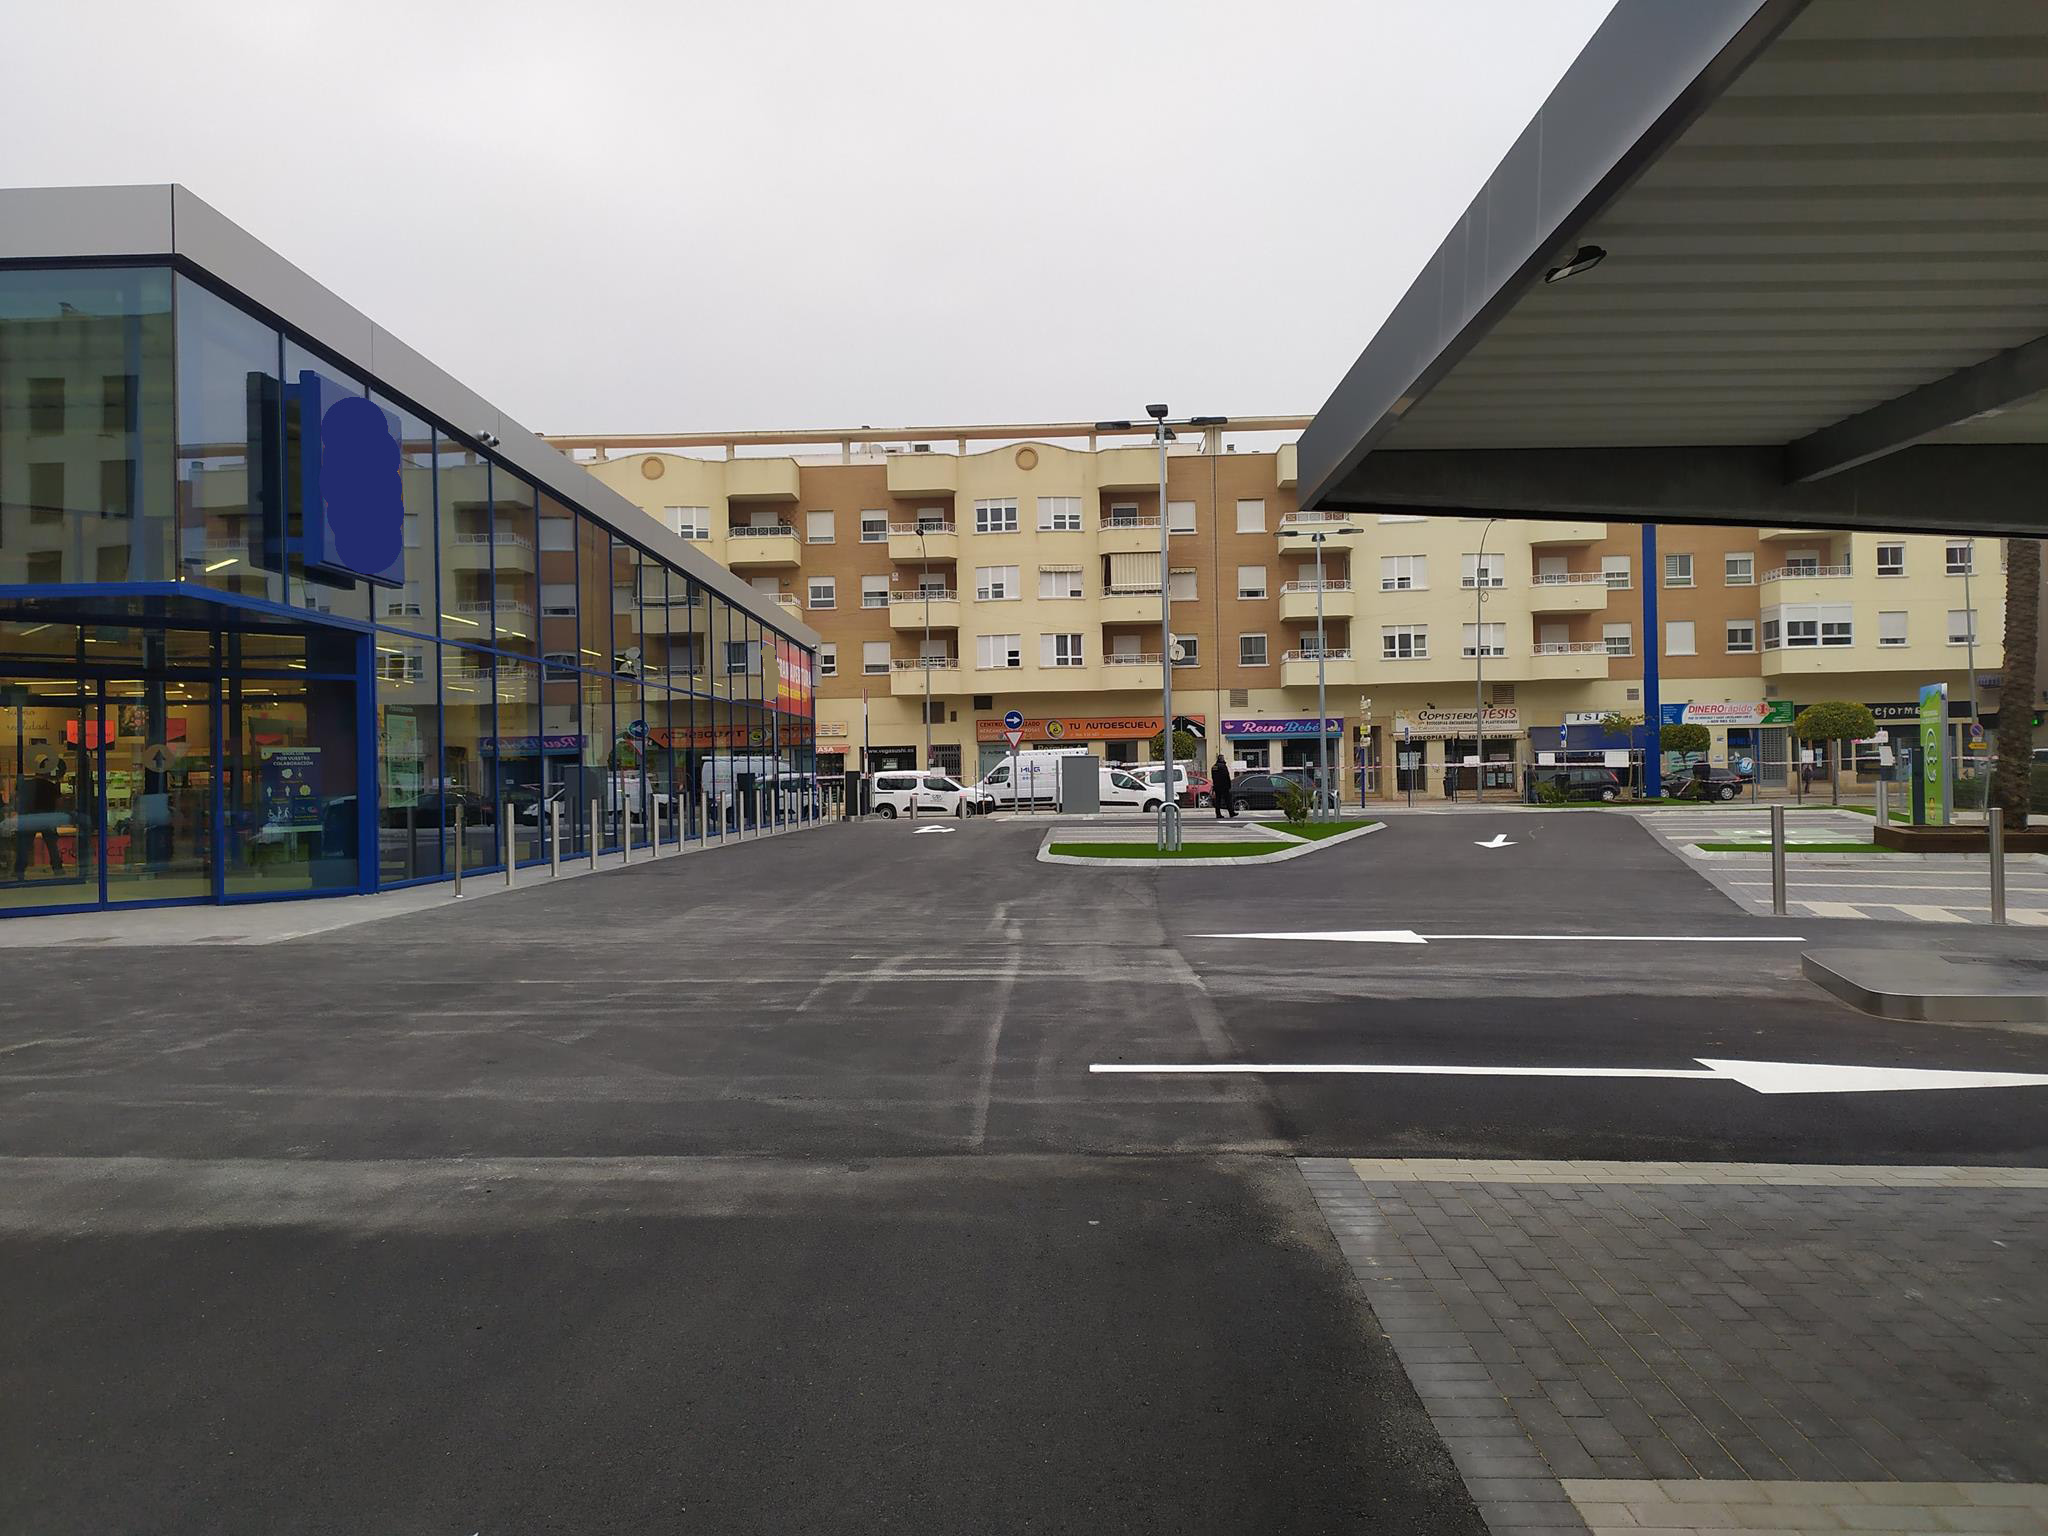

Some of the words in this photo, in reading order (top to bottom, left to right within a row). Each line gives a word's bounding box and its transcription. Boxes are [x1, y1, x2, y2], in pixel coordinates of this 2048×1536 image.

[1688, 705, 1725, 713] DINERO
[1418, 710, 1479, 721] COPISTERIA
[1481, 708, 1517, 719] TESIS
[1069, 722, 1081, 730] TU
[1085, 721, 1158, 729] AUTOESCUELA
[1241, 722, 1284, 732] Reino
[1284, 722, 1321, 732] Bebé
